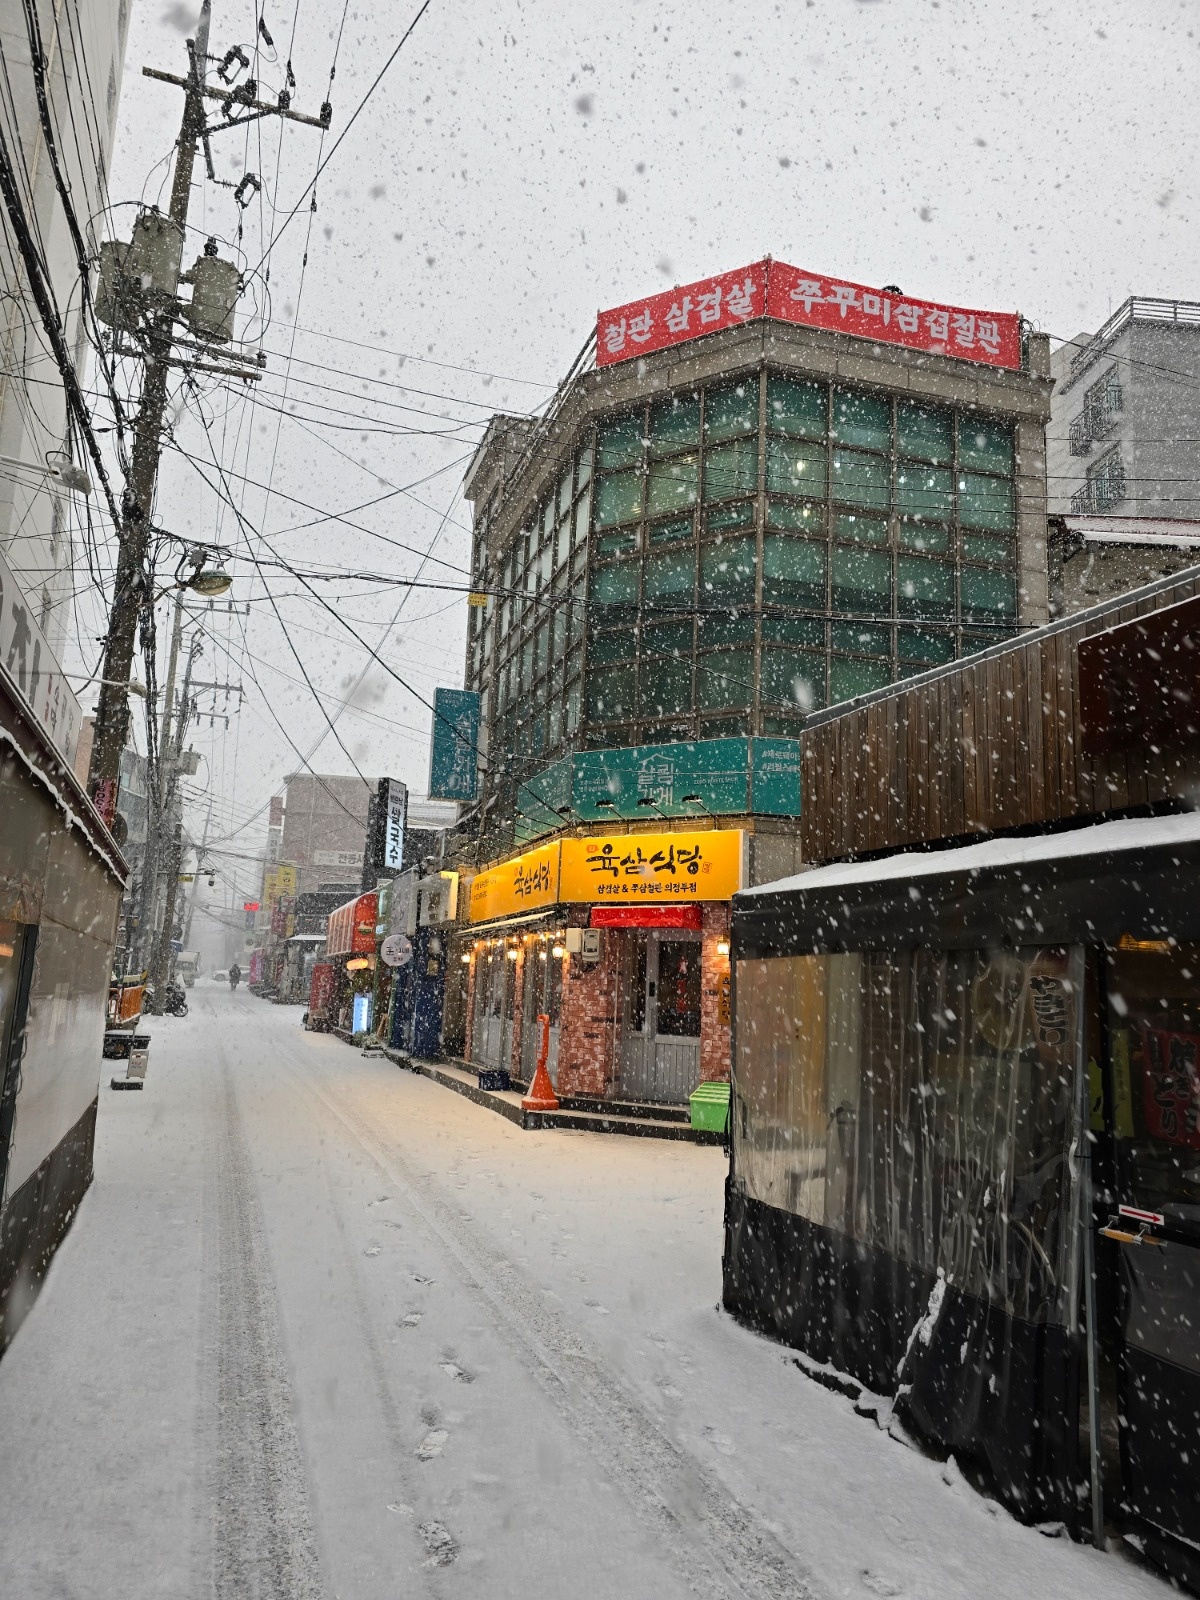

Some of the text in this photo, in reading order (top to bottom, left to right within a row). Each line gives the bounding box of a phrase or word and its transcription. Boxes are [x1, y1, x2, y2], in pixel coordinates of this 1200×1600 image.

[603, 277, 757, 353] 철판 삼겹살
[585, 843, 703, 877] 육삼식당
[513, 860, 551, 898] 육삼식당
[597, 883, 621, 894] 삼겹살
[622, 884, 629, 893] &
[664, 882, 697, 893] 의정부점
